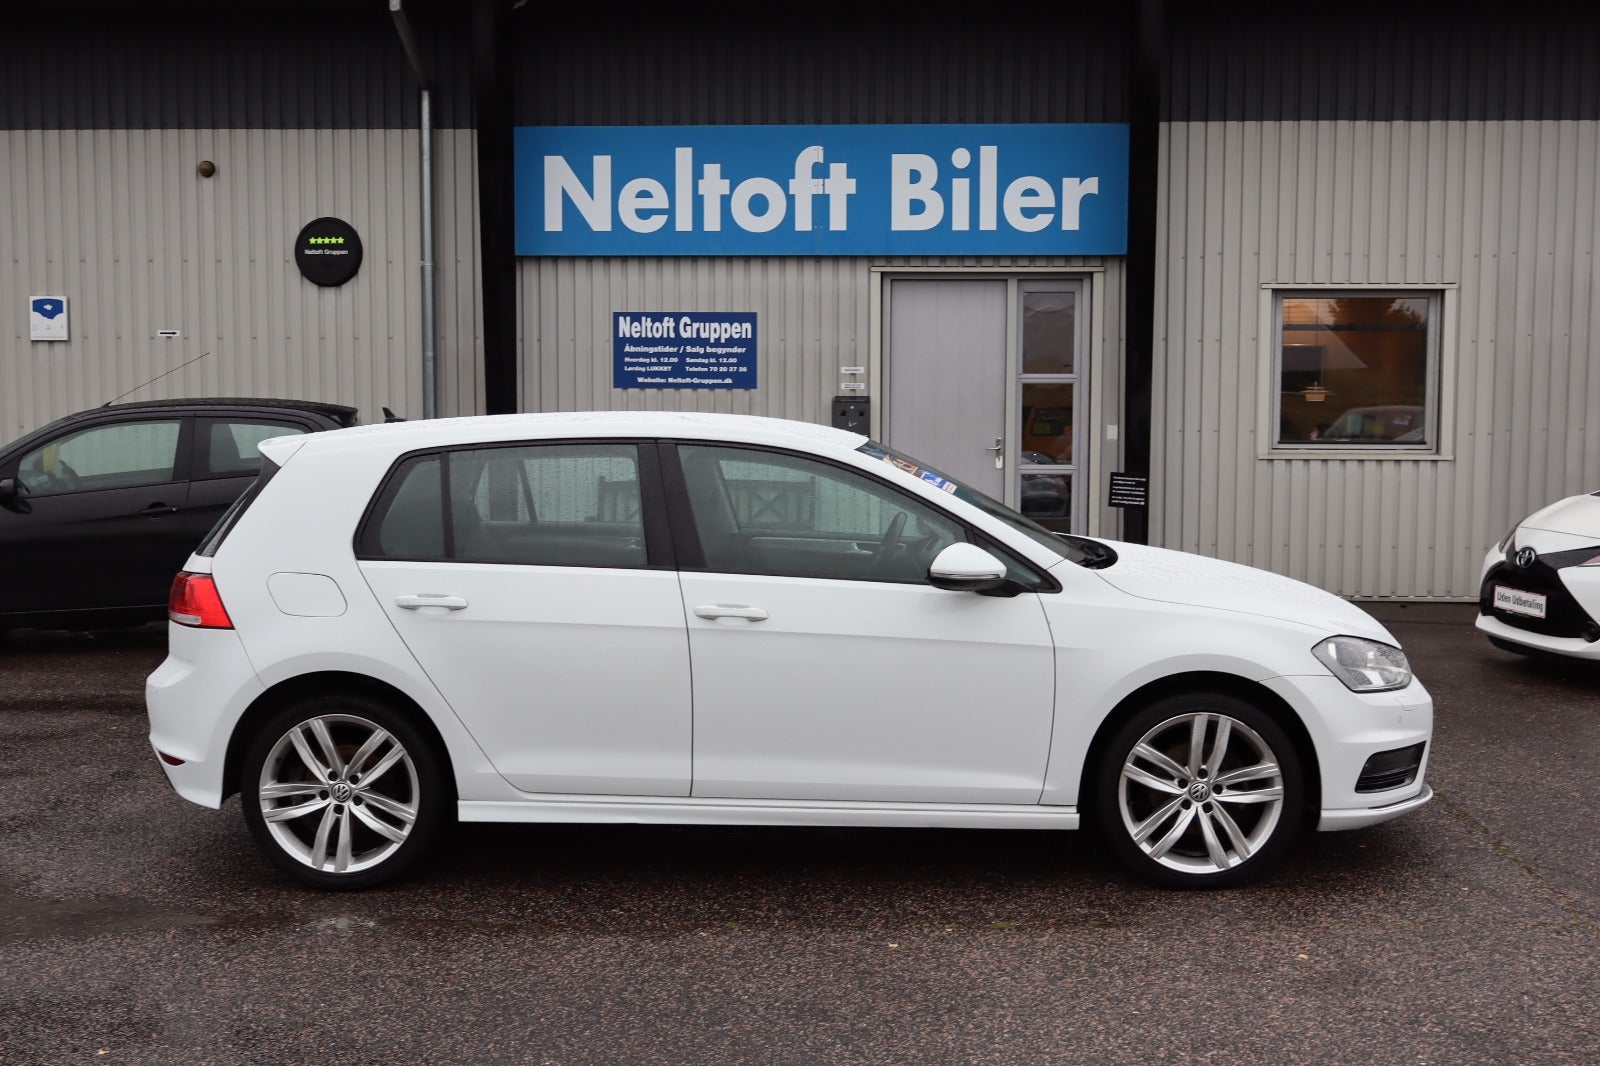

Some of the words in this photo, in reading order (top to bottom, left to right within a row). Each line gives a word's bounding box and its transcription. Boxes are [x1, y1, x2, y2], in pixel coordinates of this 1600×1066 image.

[543, 145, 856, 233] Neltoft
[891, 145, 1099, 232] Biler
[618, 316, 675, 338] Neltoft
[679, 316, 752, 343] Gruppen
[624, 343, 678, 353] Åbningstider
[685, 346, 705, 354] Salg
[706, 346, 746, 354] begynder
[1497, 591, 1511, 603] Uden
